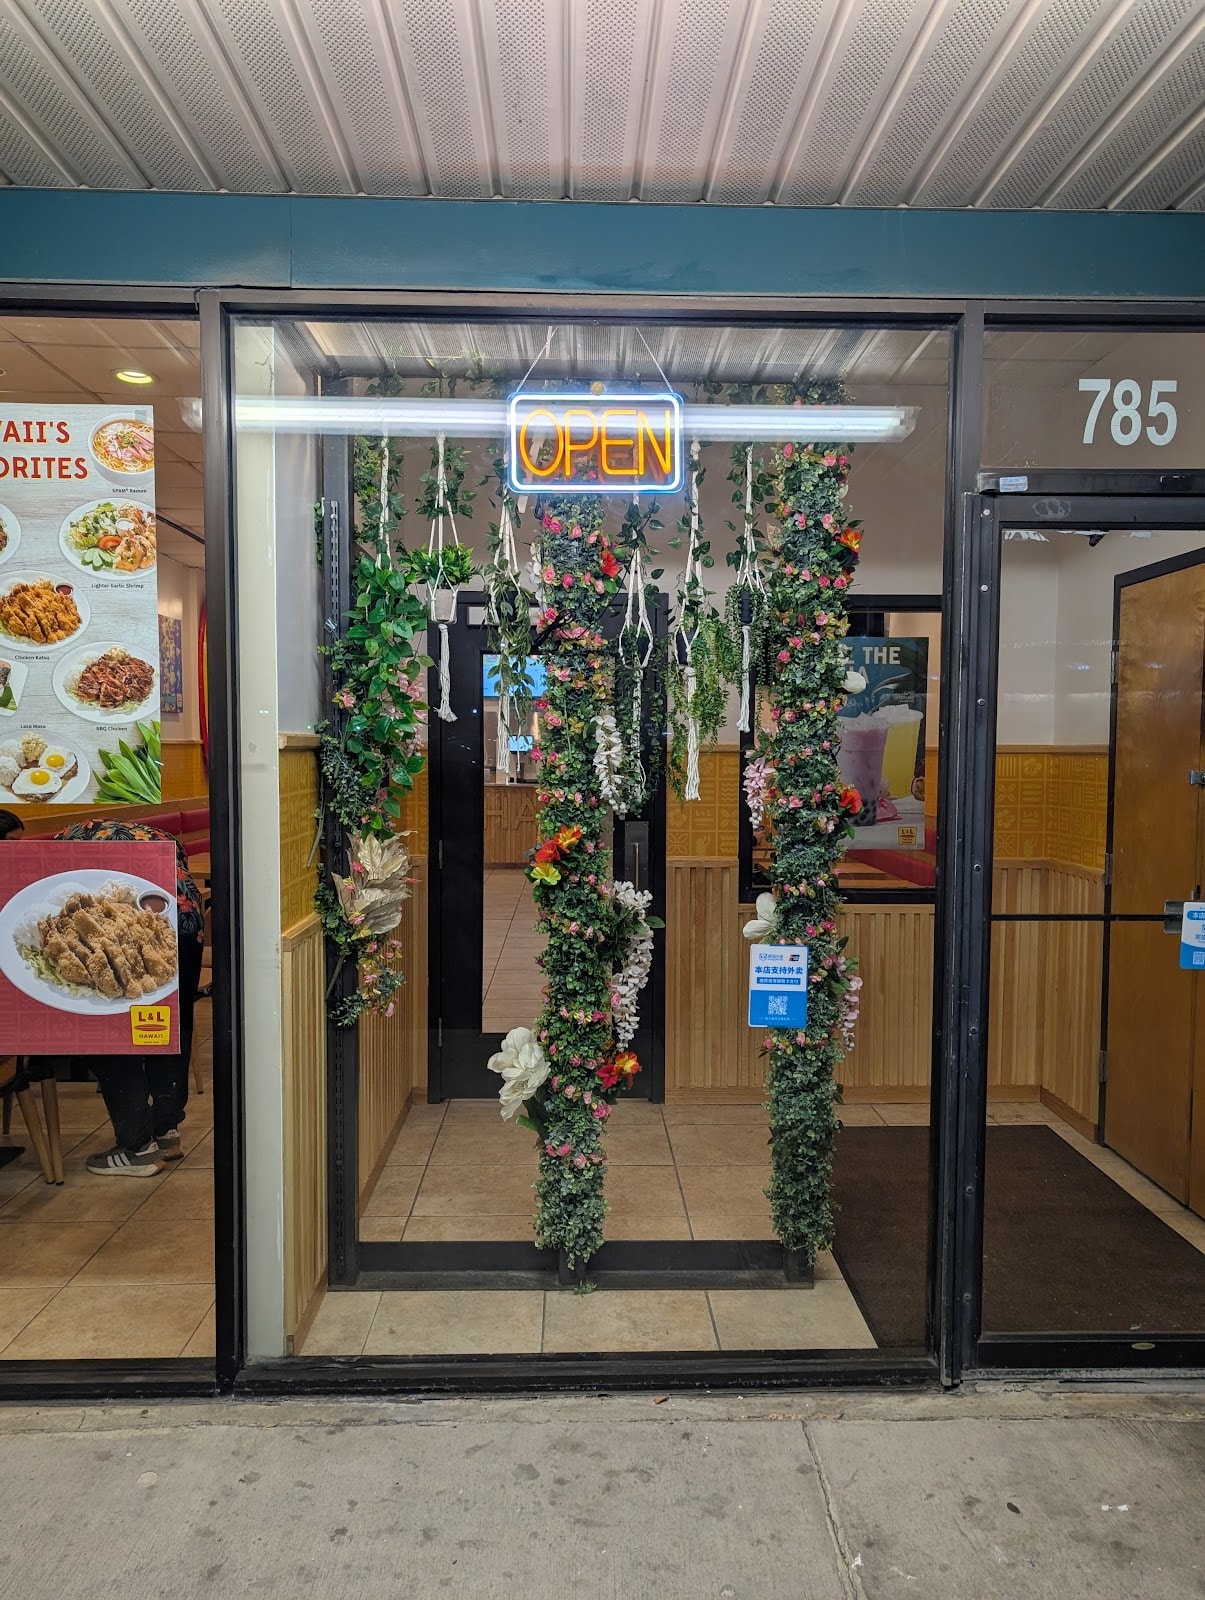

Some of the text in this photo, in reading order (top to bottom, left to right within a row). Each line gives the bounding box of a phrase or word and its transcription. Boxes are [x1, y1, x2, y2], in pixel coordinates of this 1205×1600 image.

[1079, 378, 1178, 446] 785
[0, 420, 70, 443] AII'S
[519, 408, 672, 477] OPEN
[862, 646, 901, 665] THE
[755, 966, 803, 975] 本店支持外卖
